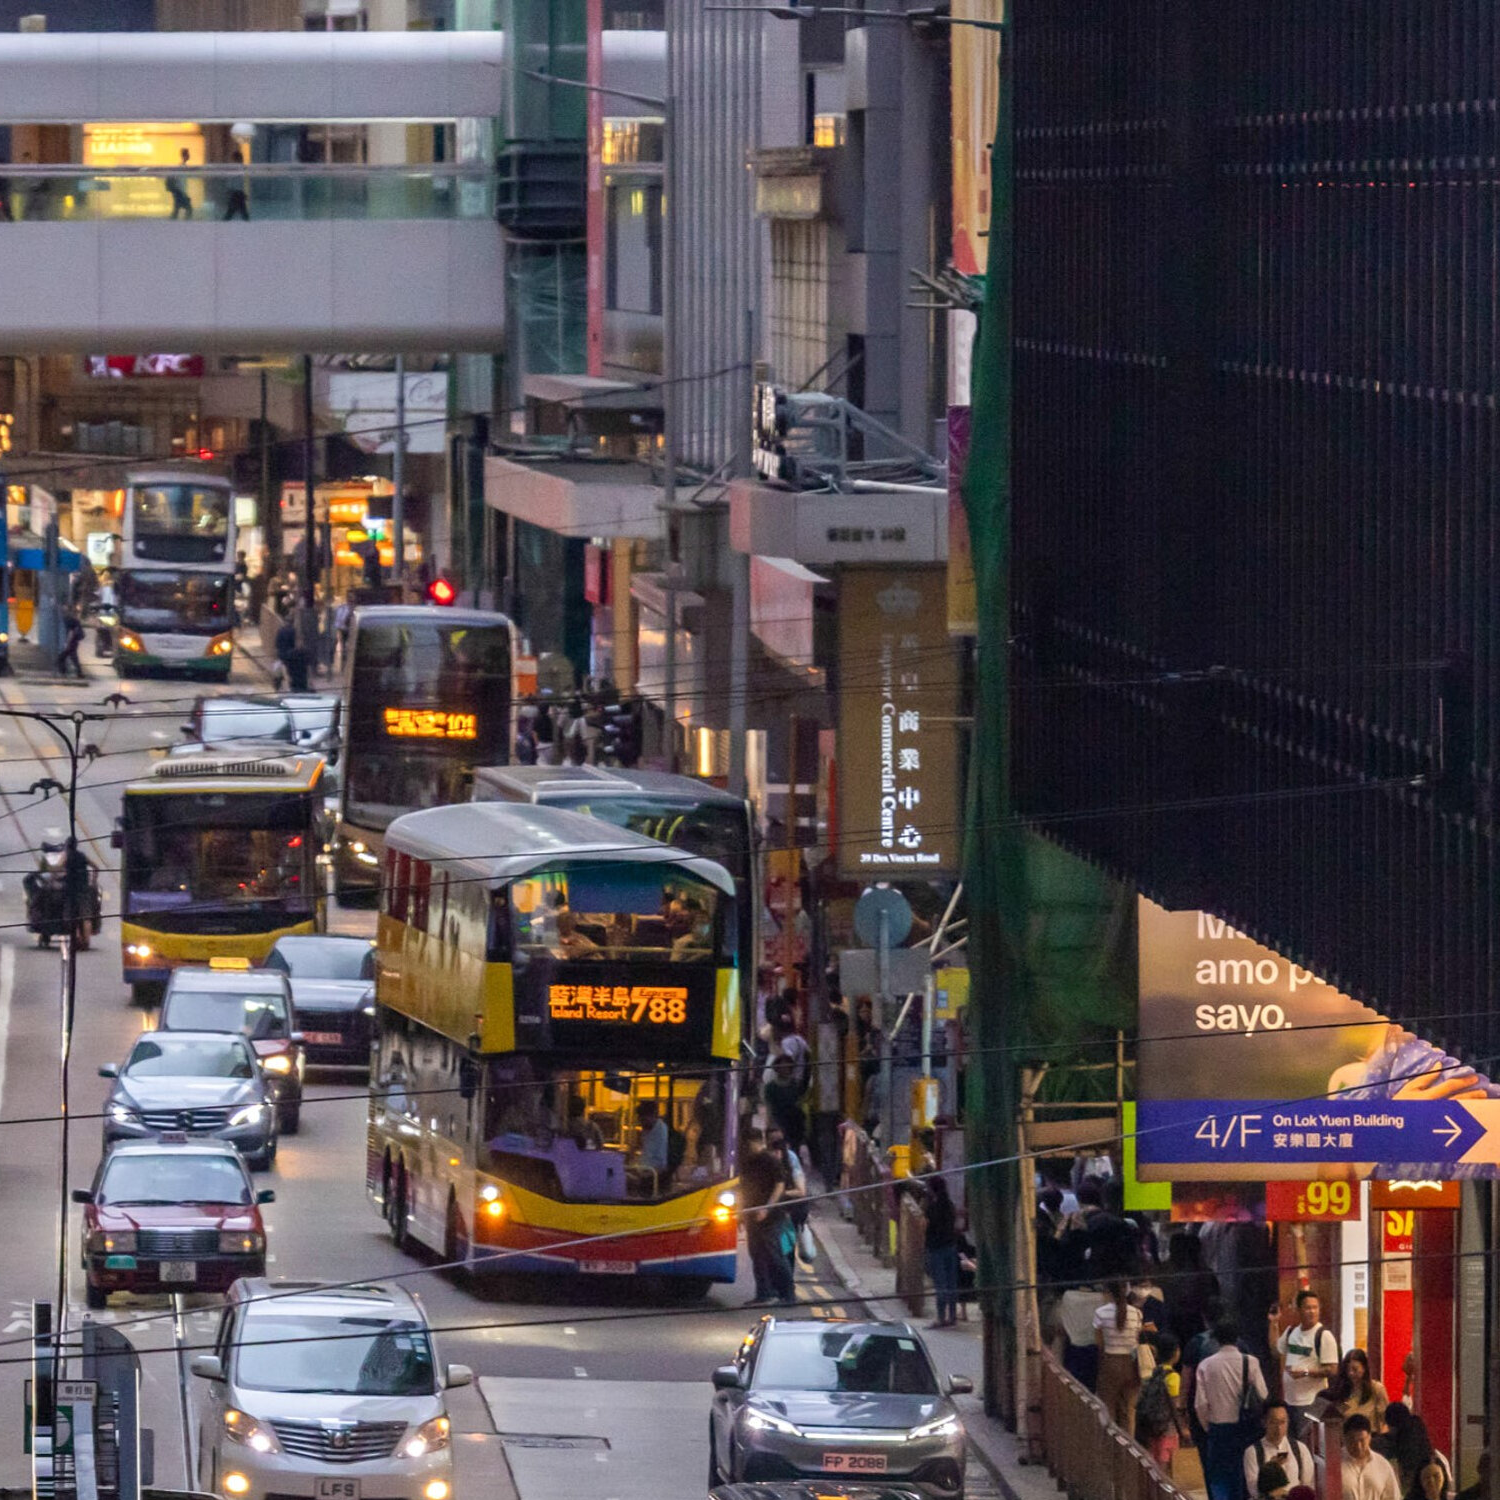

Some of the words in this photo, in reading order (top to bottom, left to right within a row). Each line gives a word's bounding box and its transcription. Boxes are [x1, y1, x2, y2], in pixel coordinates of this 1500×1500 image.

[133, 354, 190, 374] KFC
[881, 703, 895, 793] Commercial
[881, 796, 897, 848] Centre
[916, 853, 940, 863] Road
[1195, 959, 1279, 985] amo
[551, 1006, 584, 1018] Island
[586, 1006, 627, 1020] Resort
[631, 999, 687, 1023] 788
[1195, 1004, 1292, 1038] sayo.
[1195, 1115, 1262, 1148] 4/F
[1273, 1115, 1292, 1127] On
[1294, 1114, 1317, 1127] Lok
[1319, 1115, 1350, 1127] Yuen
[1353, 1114, 1404, 1129] Building
[825, 1456, 843, 1468] FP
